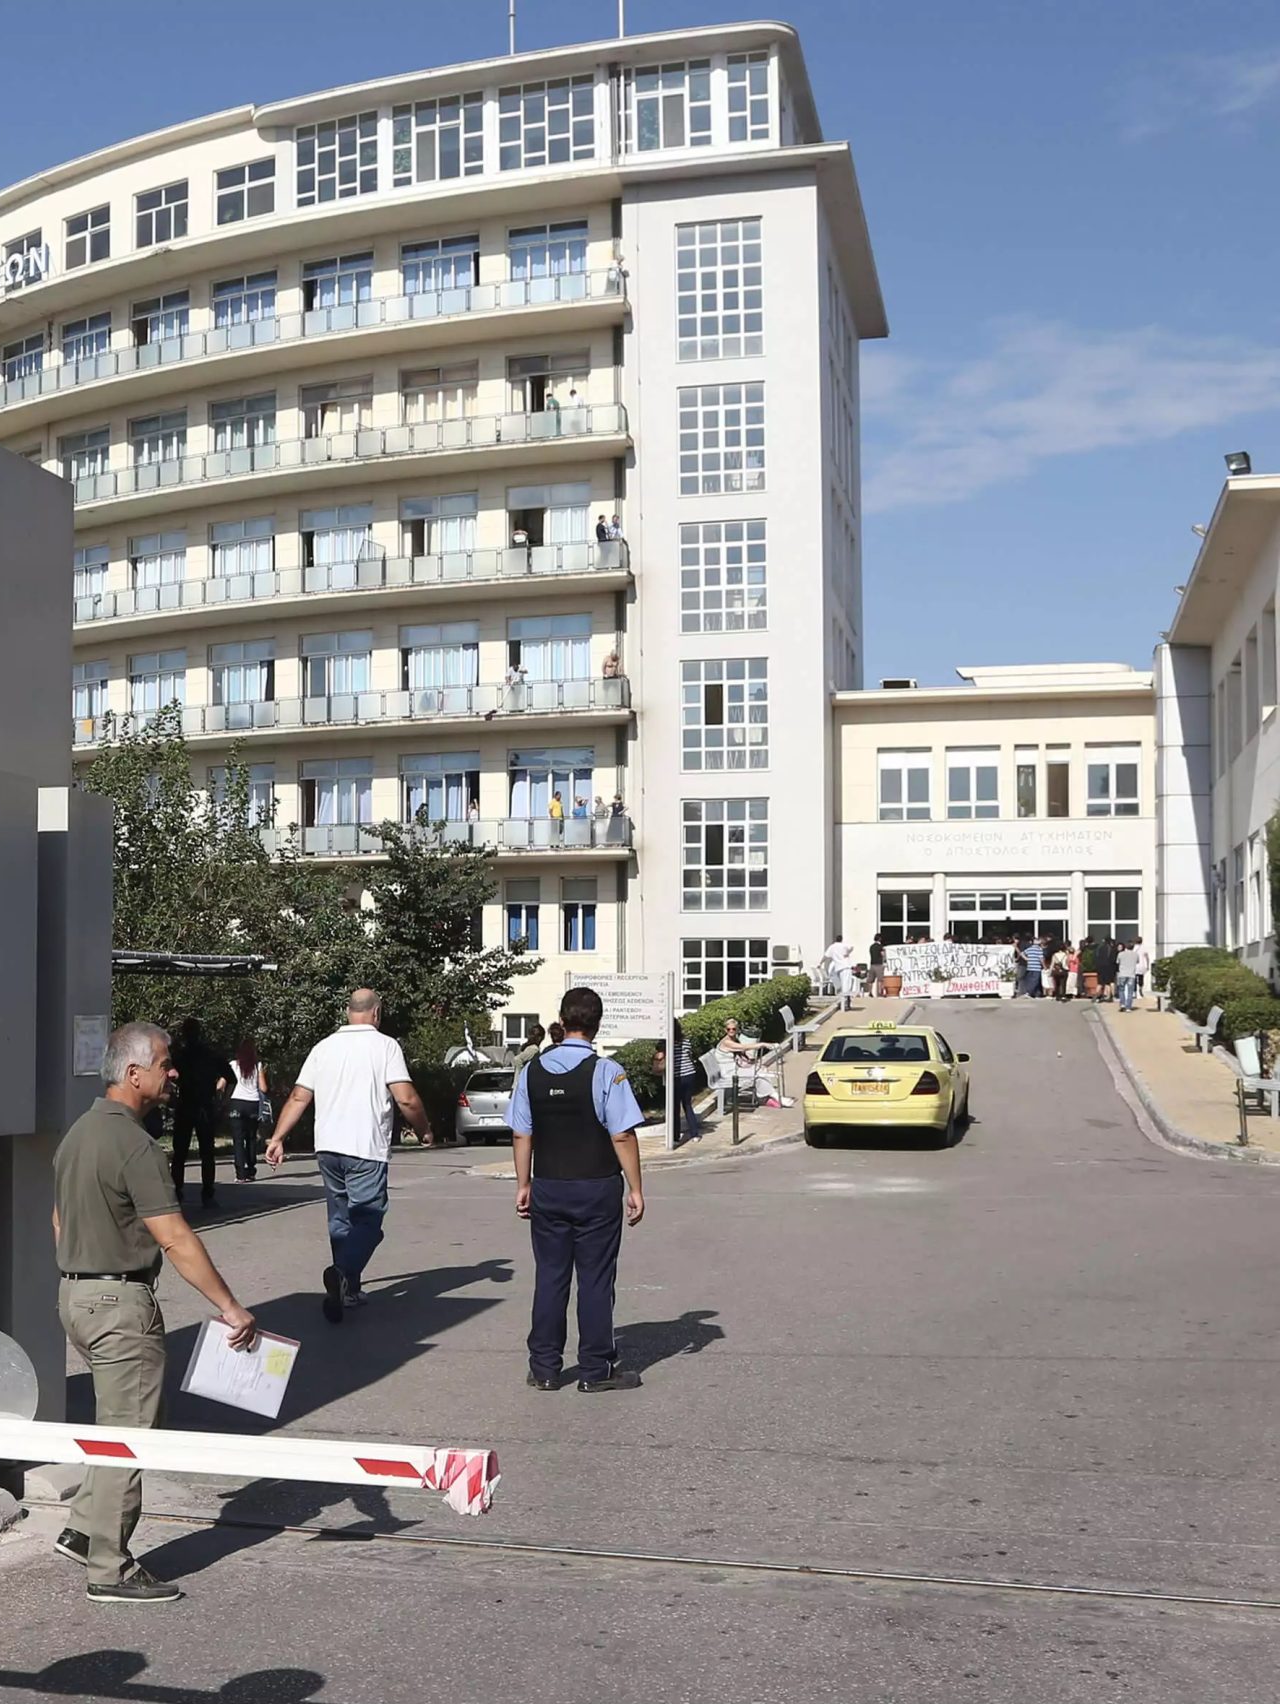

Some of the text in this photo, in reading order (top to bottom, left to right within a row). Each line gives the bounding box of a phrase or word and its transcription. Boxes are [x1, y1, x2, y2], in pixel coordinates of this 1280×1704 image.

[906, 830, 1113, 844] ΝΟΣΟΚΟΜΕΙΟΝ ΑΤΥΧΗΜΑΤΩΝ
[946, 845, 1030, 857] ΑΠΟΣΤΟΛΟΣ
[1041, 844, 1095, 856] ΠΑΥΛΟΣ
